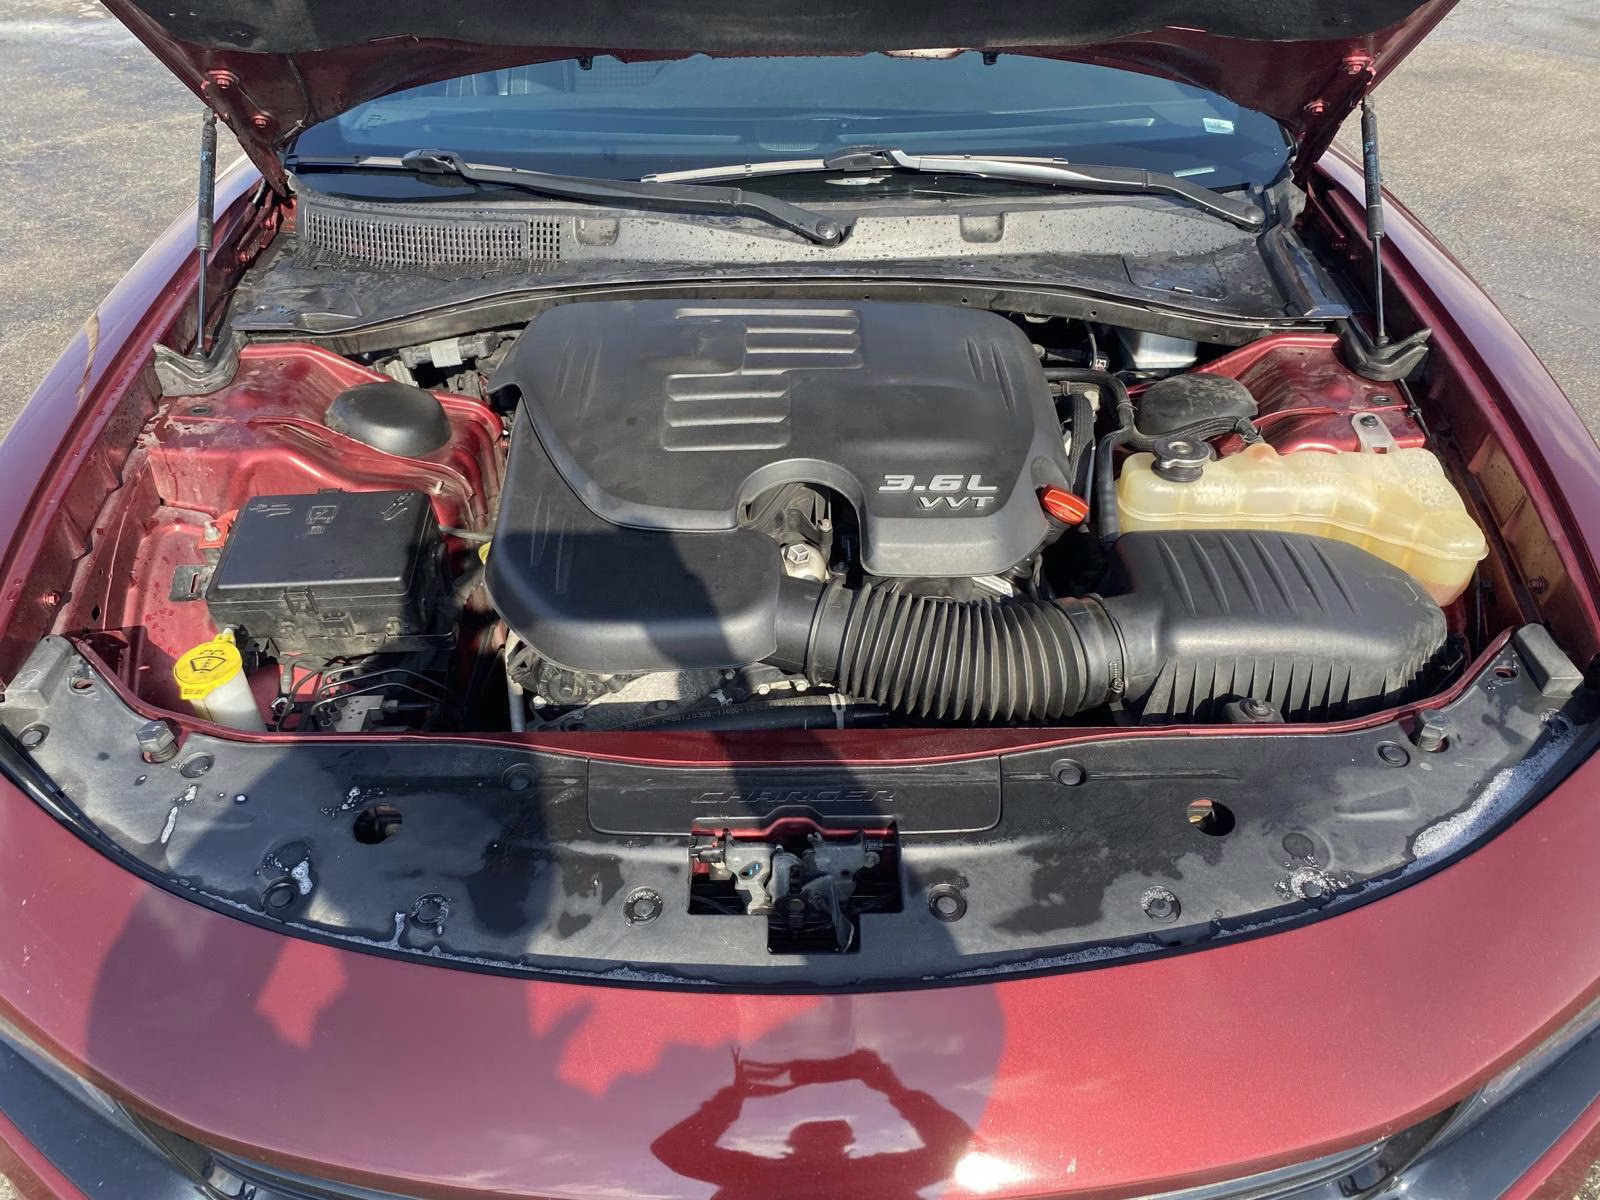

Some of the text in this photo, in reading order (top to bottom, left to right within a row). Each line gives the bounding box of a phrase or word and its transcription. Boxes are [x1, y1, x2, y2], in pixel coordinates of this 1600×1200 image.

[878, 474, 998, 492] 3.6L
[918, 496, 995, 511] VVT
[691, 790, 897, 804] CHARGER
